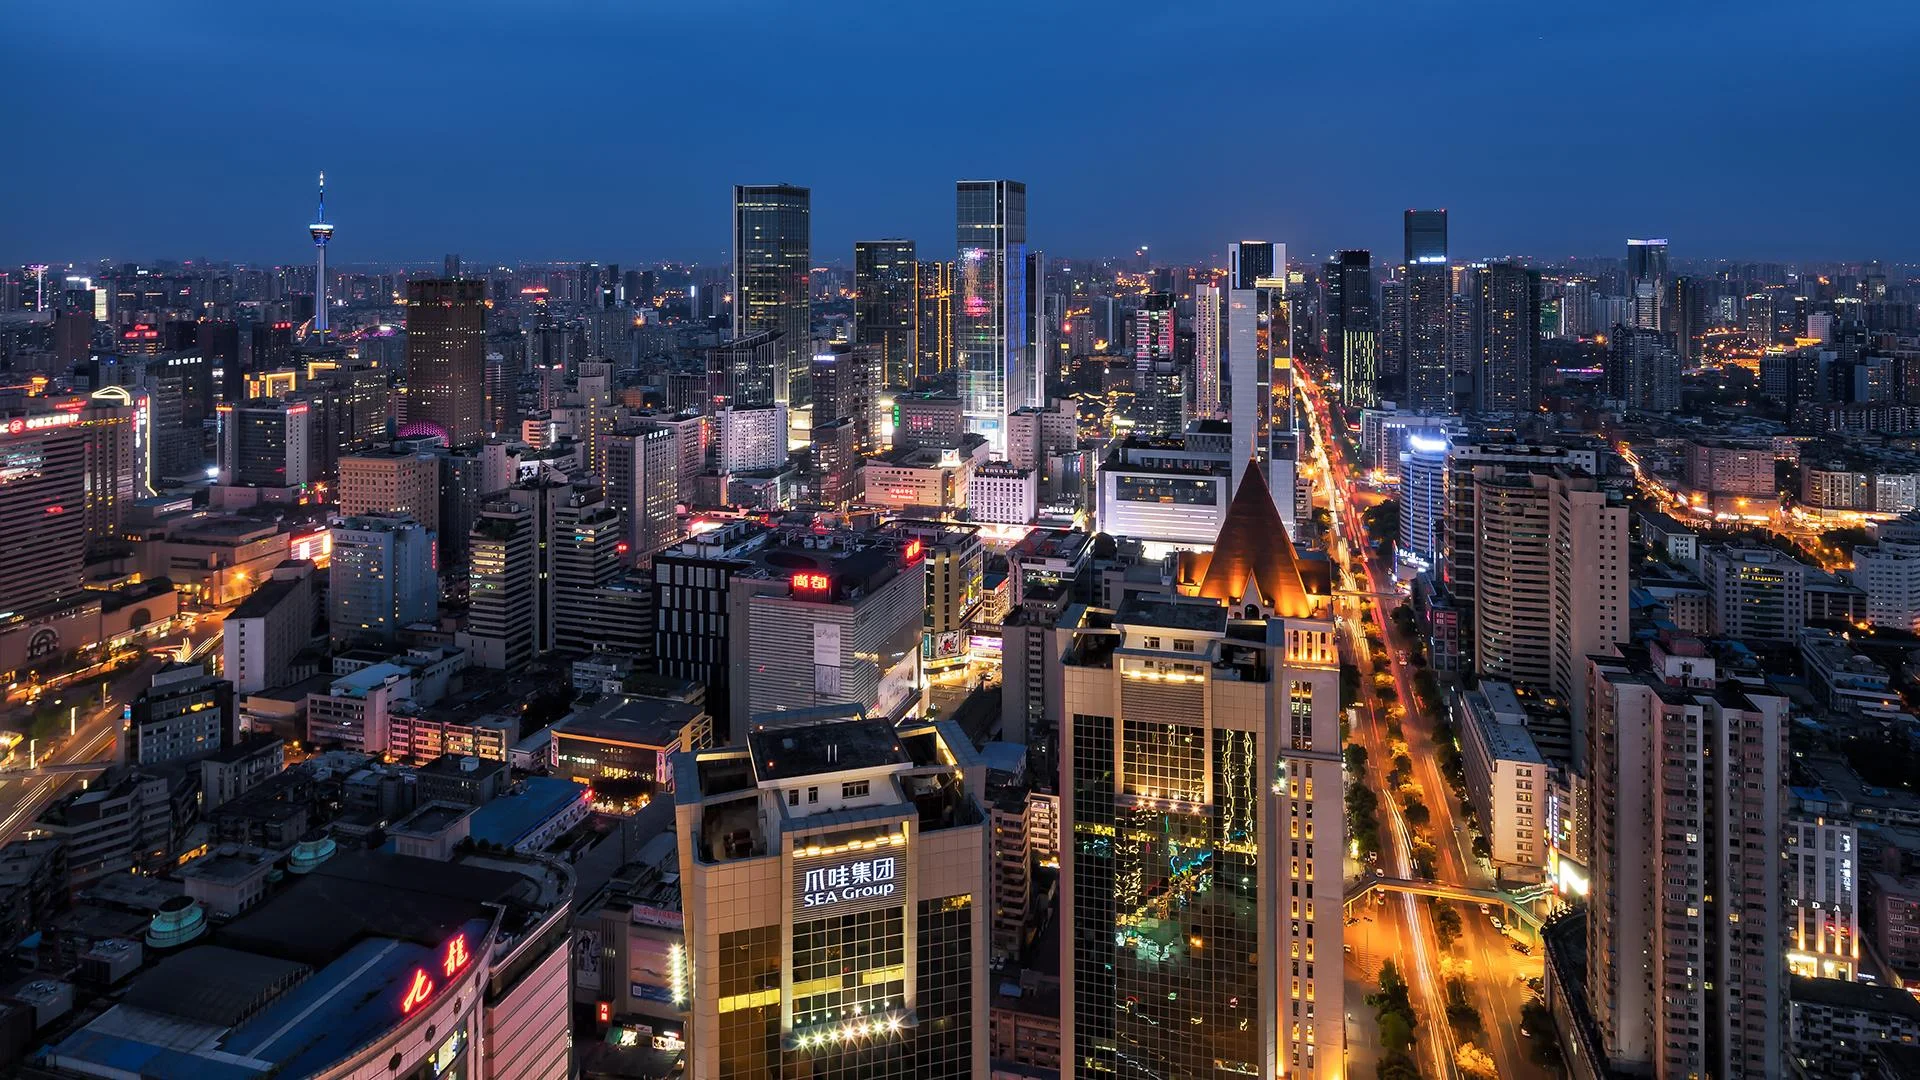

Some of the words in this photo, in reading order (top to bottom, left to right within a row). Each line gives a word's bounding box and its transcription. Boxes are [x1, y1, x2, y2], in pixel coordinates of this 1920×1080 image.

[793, 575, 827, 589] 尚都
[805, 857, 894, 892] 爪哇集团
[804, 891, 838, 907] SEA
[842, 883, 894, 900] Group
